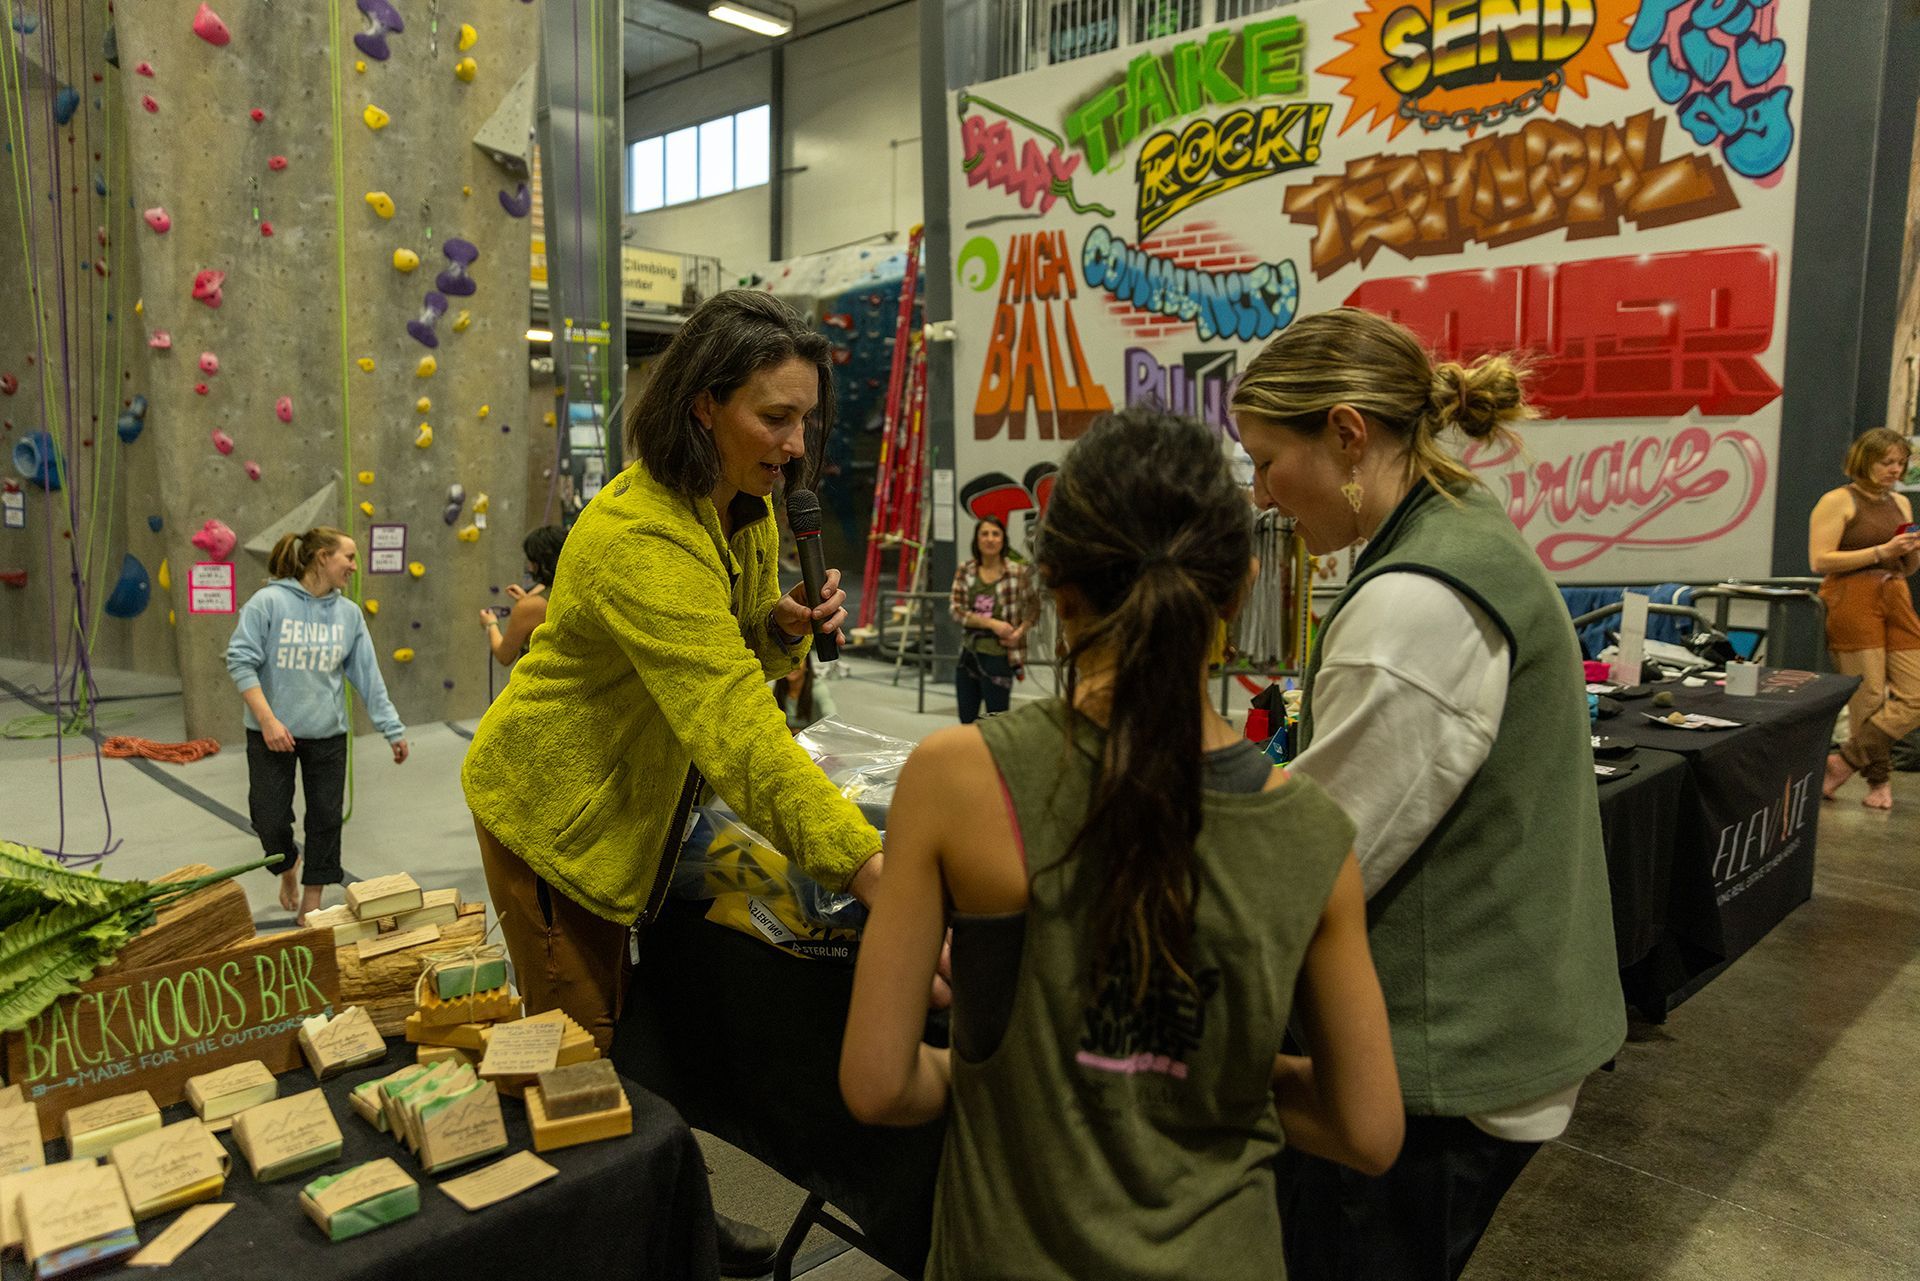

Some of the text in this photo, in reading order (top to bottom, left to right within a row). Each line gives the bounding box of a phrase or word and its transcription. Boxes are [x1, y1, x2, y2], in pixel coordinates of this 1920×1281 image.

[1065, 15, 1308, 174] TAKE
[1379, 0, 1597, 99] SEND
[962, 115, 1081, 214] BELAY
[1137, 103, 1332, 216] ROCK!
[1000, 230, 1077, 301] HIGH
[1082, 224, 1299, 342] COMMUNITY
[974, 300, 1114, 440] BALL
[276, 645, 343, 673] SISTER
[280, 618, 345, 643] SEND IT
[802, 945, 849, 958] STERLING
[24, 945, 333, 1082] BACKWOODS BAR
[77, 1060, 135, 1087] MADE
[140, 1050, 178, 1070] FOR
[182, 1038, 219, 1057] THE
[221, 1013, 306, 1047] OUTDOORS
